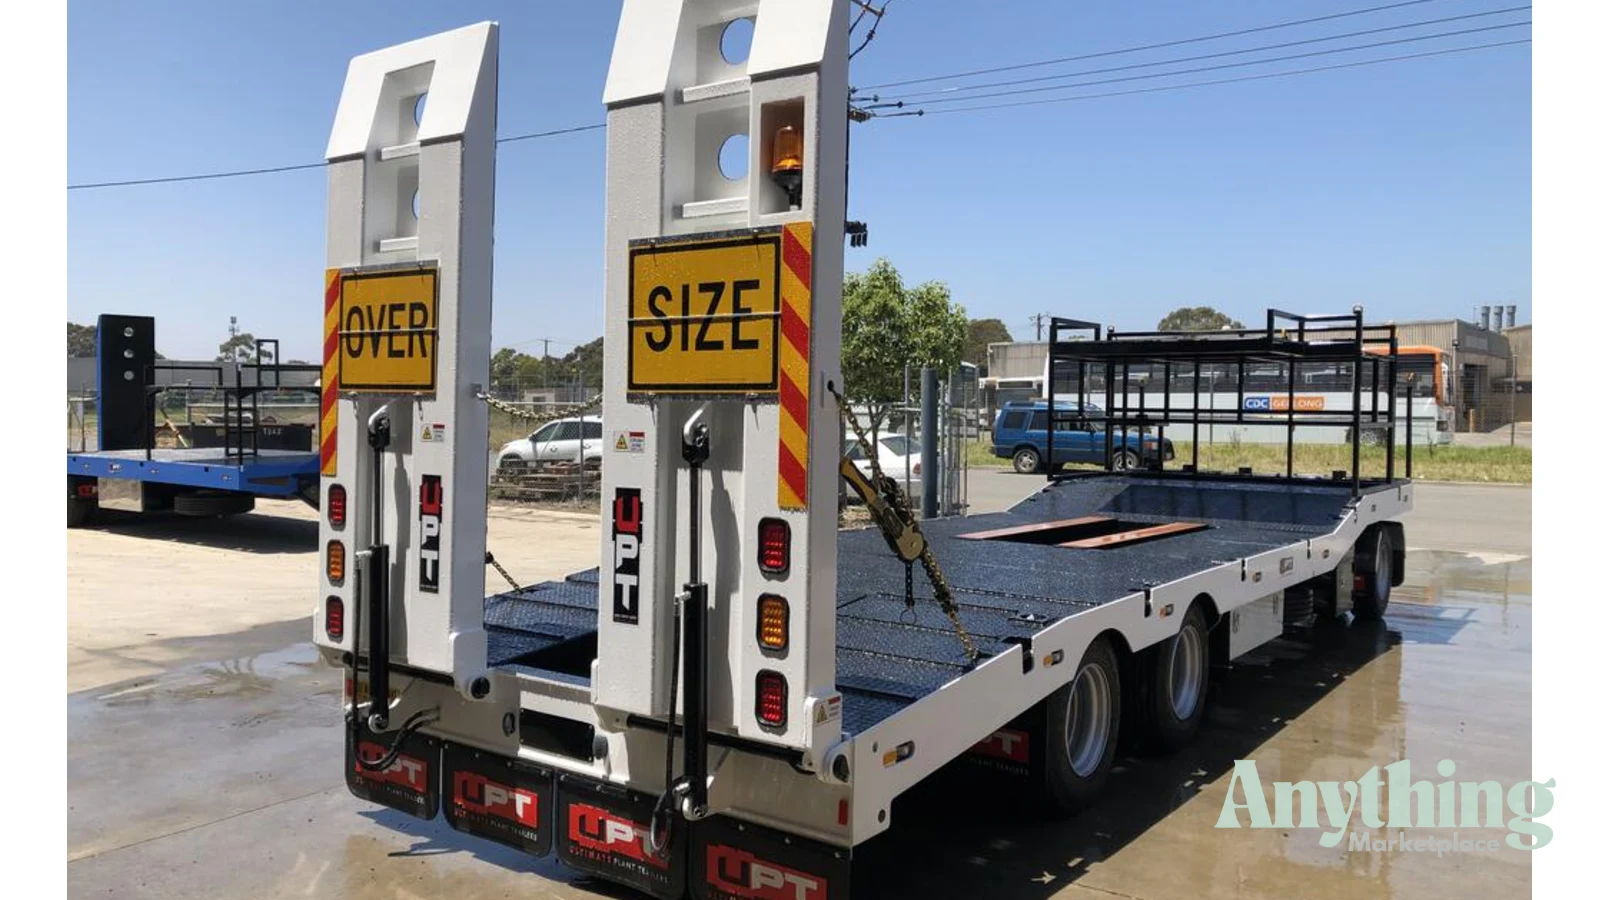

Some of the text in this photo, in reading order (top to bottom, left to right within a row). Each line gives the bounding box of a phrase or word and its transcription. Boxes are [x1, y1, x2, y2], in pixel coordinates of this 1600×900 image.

[345, 302, 428, 359] OVER
[645, 279, 760, 352] SIZE
[1245, 398, 1268, 409] CDC
[420, 480, 441, 582] UPT
[615, 496, 639, 611] UPT
[461, 779, 532, 818] UPT
[578, 813, 656, 857] UPT
[718, 856, 818, 900] UPT
